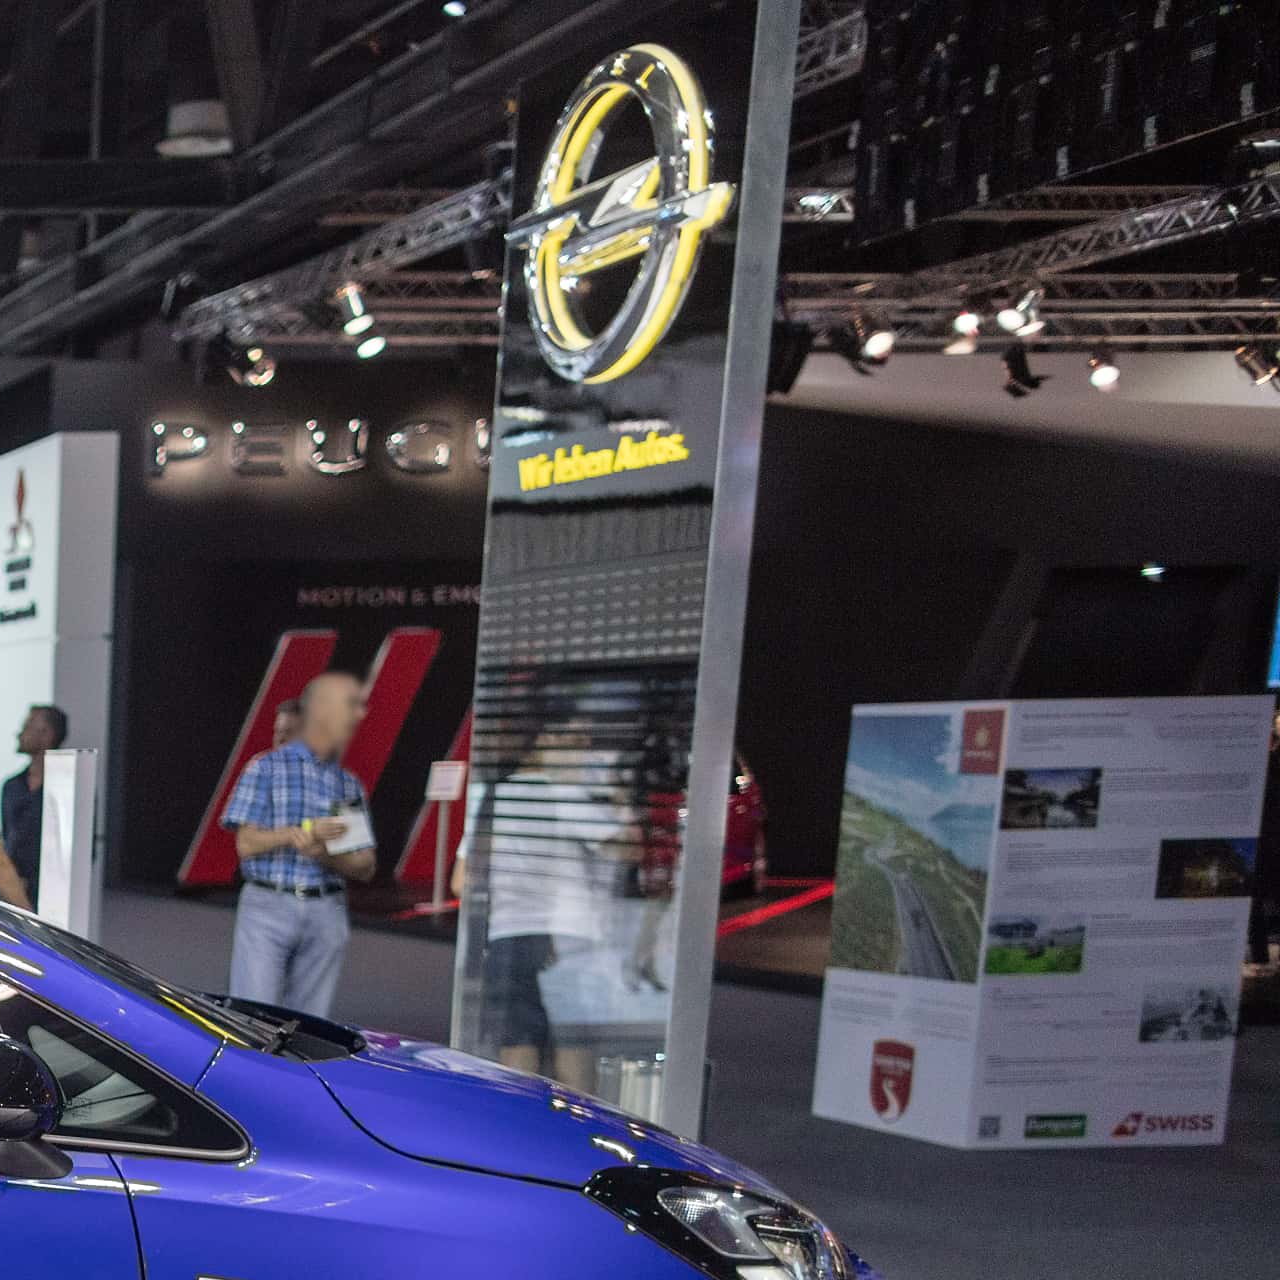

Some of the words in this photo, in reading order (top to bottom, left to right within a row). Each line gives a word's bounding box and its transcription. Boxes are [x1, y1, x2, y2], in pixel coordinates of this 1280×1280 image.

[151, 419, 490, 476] PEUG
[518, 453, 554, 492] Wir
[1144, 1113, 1215, 1133] SWISS
